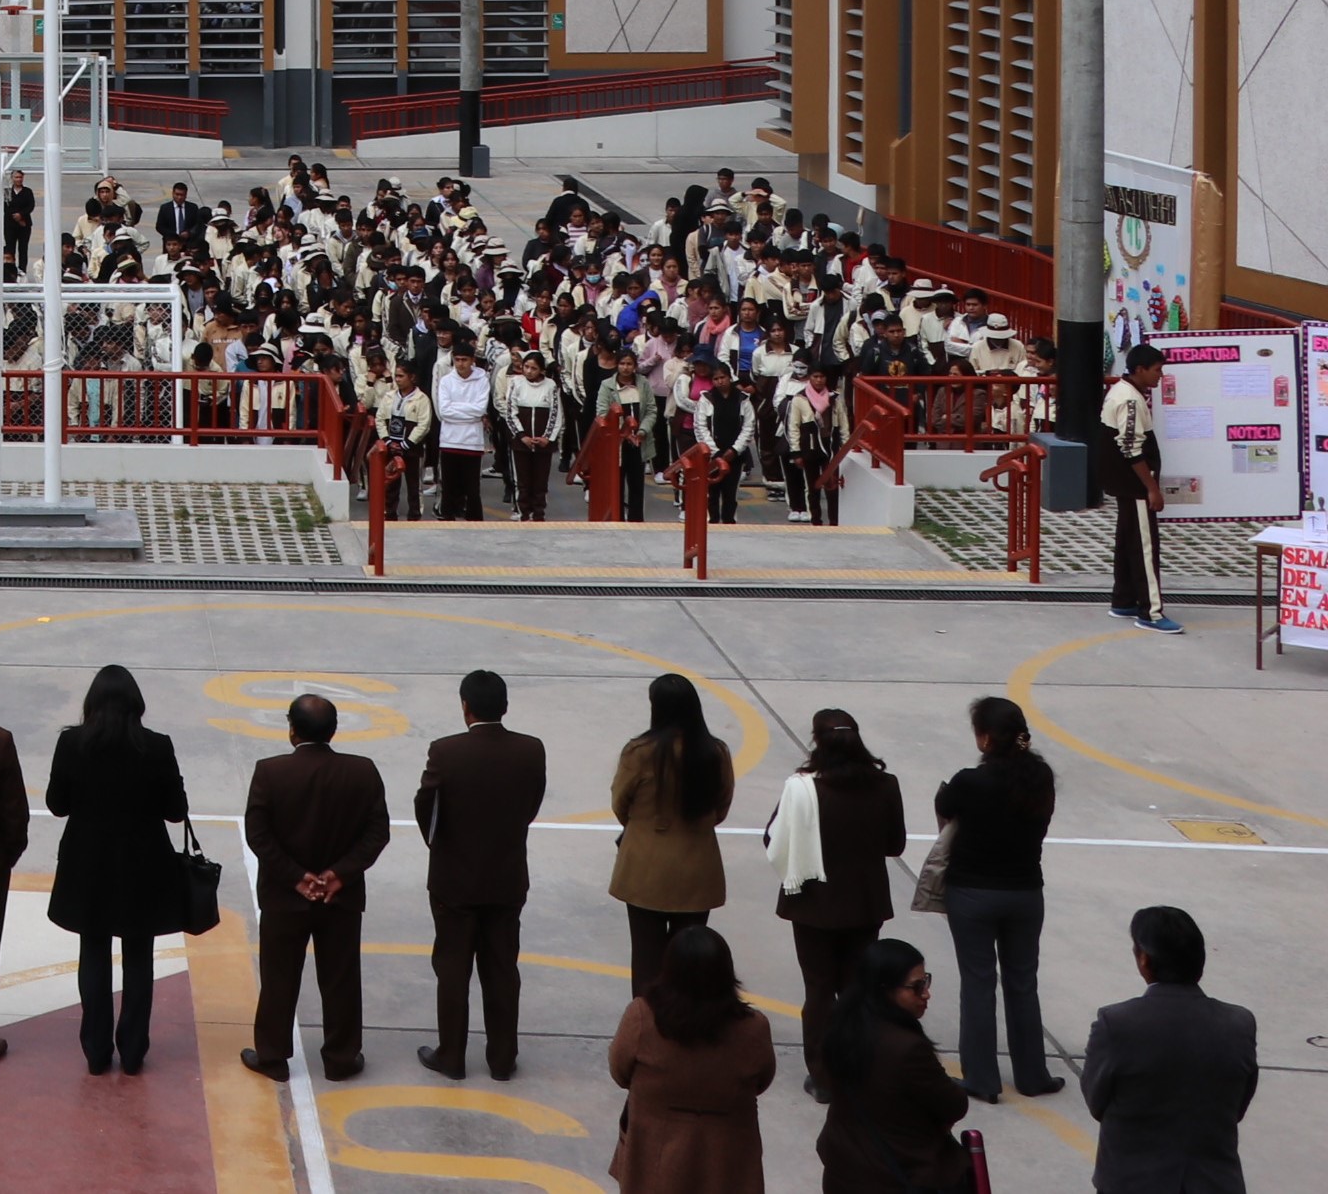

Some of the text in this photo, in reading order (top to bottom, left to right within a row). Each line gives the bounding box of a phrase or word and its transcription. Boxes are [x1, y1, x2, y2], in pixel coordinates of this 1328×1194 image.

[1165, 347, 1239, 362] LITERATURA
[1228, 426, 1280, 440] NOTICIA
[1283, 547, 1328, 569] SEM
[1283, 568, 1322, 590] DEL
[1282, 587, 1308, 607] EN
